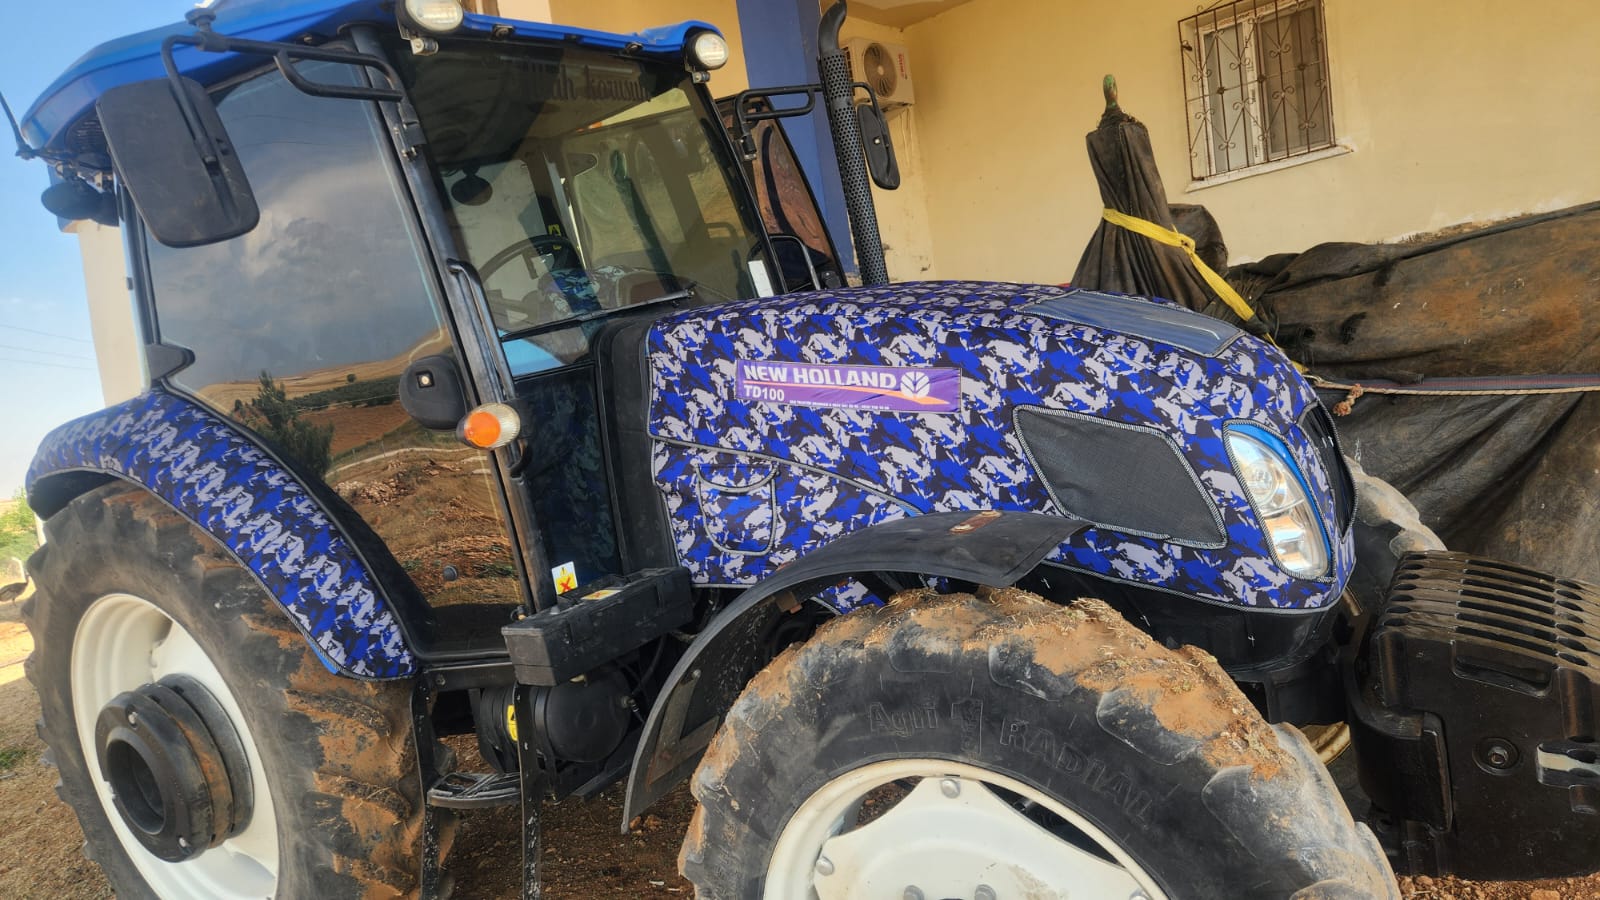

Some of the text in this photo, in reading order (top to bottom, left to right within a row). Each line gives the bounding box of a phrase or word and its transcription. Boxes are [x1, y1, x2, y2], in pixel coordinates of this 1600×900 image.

[743, 365, 897, 388] NEW HOLLAND
[743, 385, 785, 402] TD100
